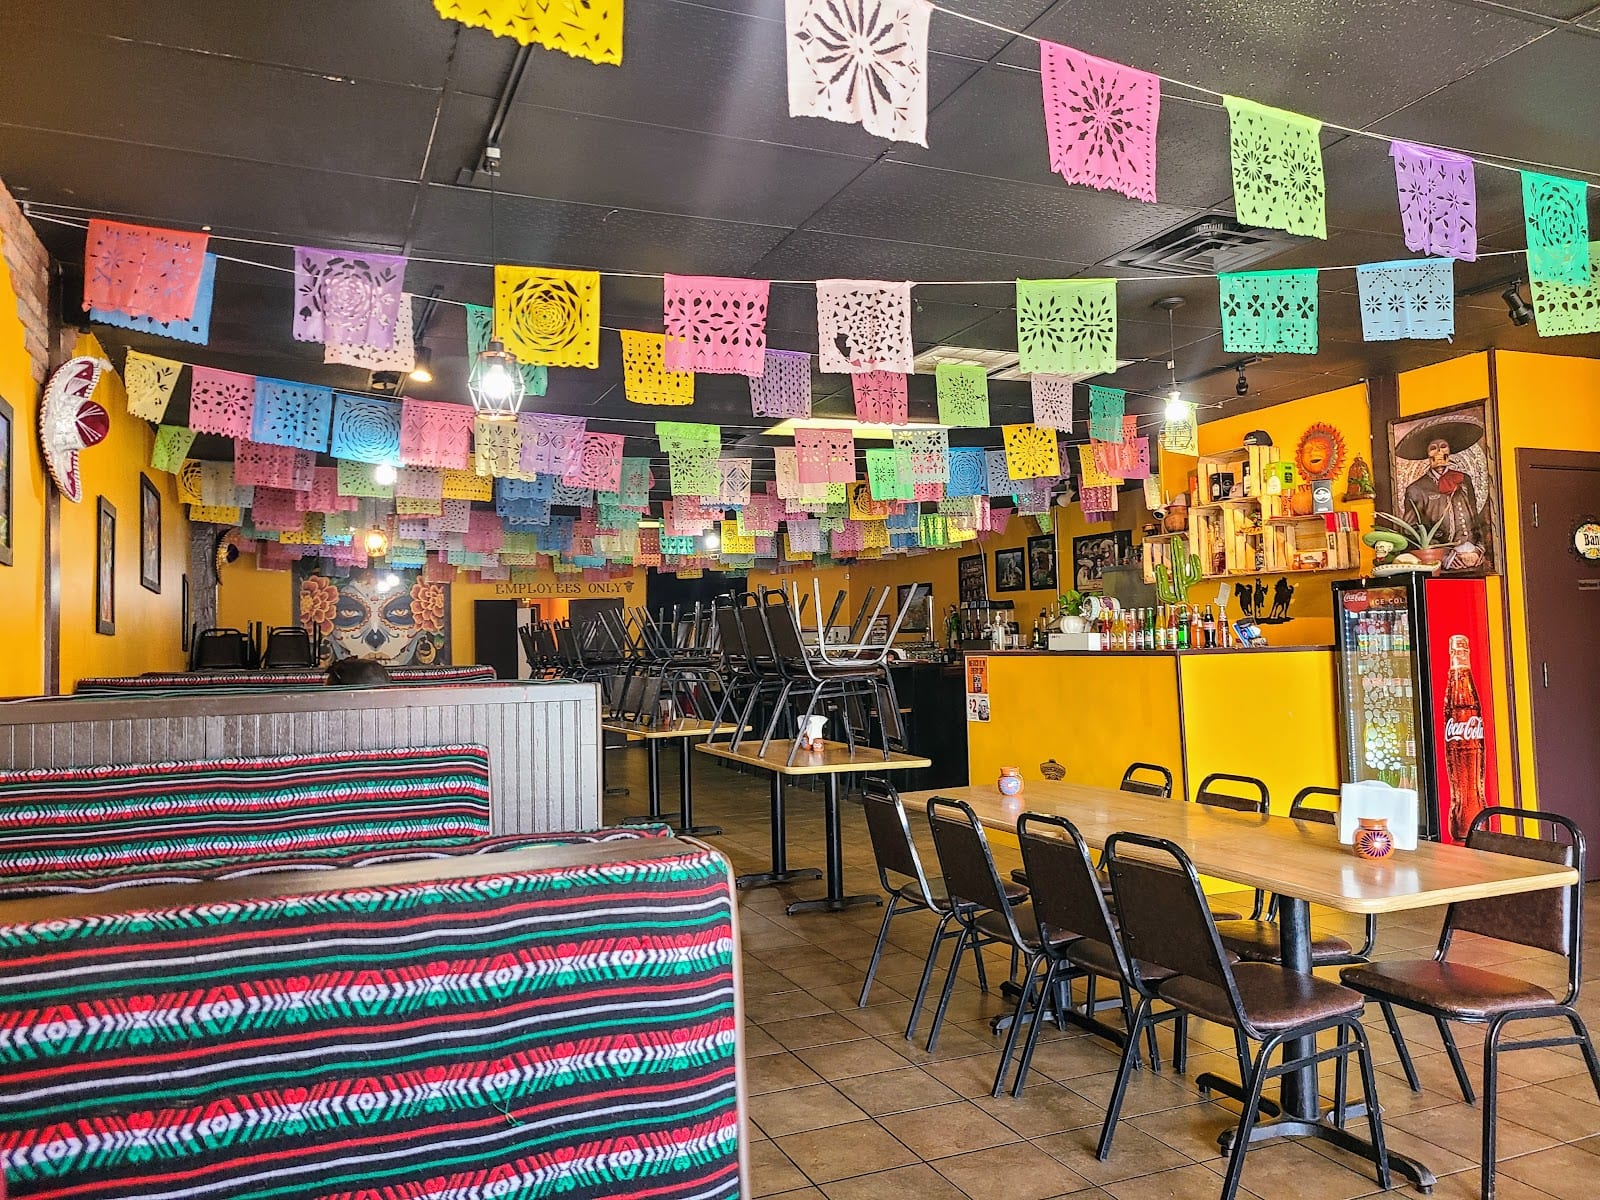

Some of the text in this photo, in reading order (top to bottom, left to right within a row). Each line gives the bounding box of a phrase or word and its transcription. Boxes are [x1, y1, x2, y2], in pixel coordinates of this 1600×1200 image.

[495, 583, 623, 594] EMPLOYEES ONLY
[969, 698, 977, 713] $2
